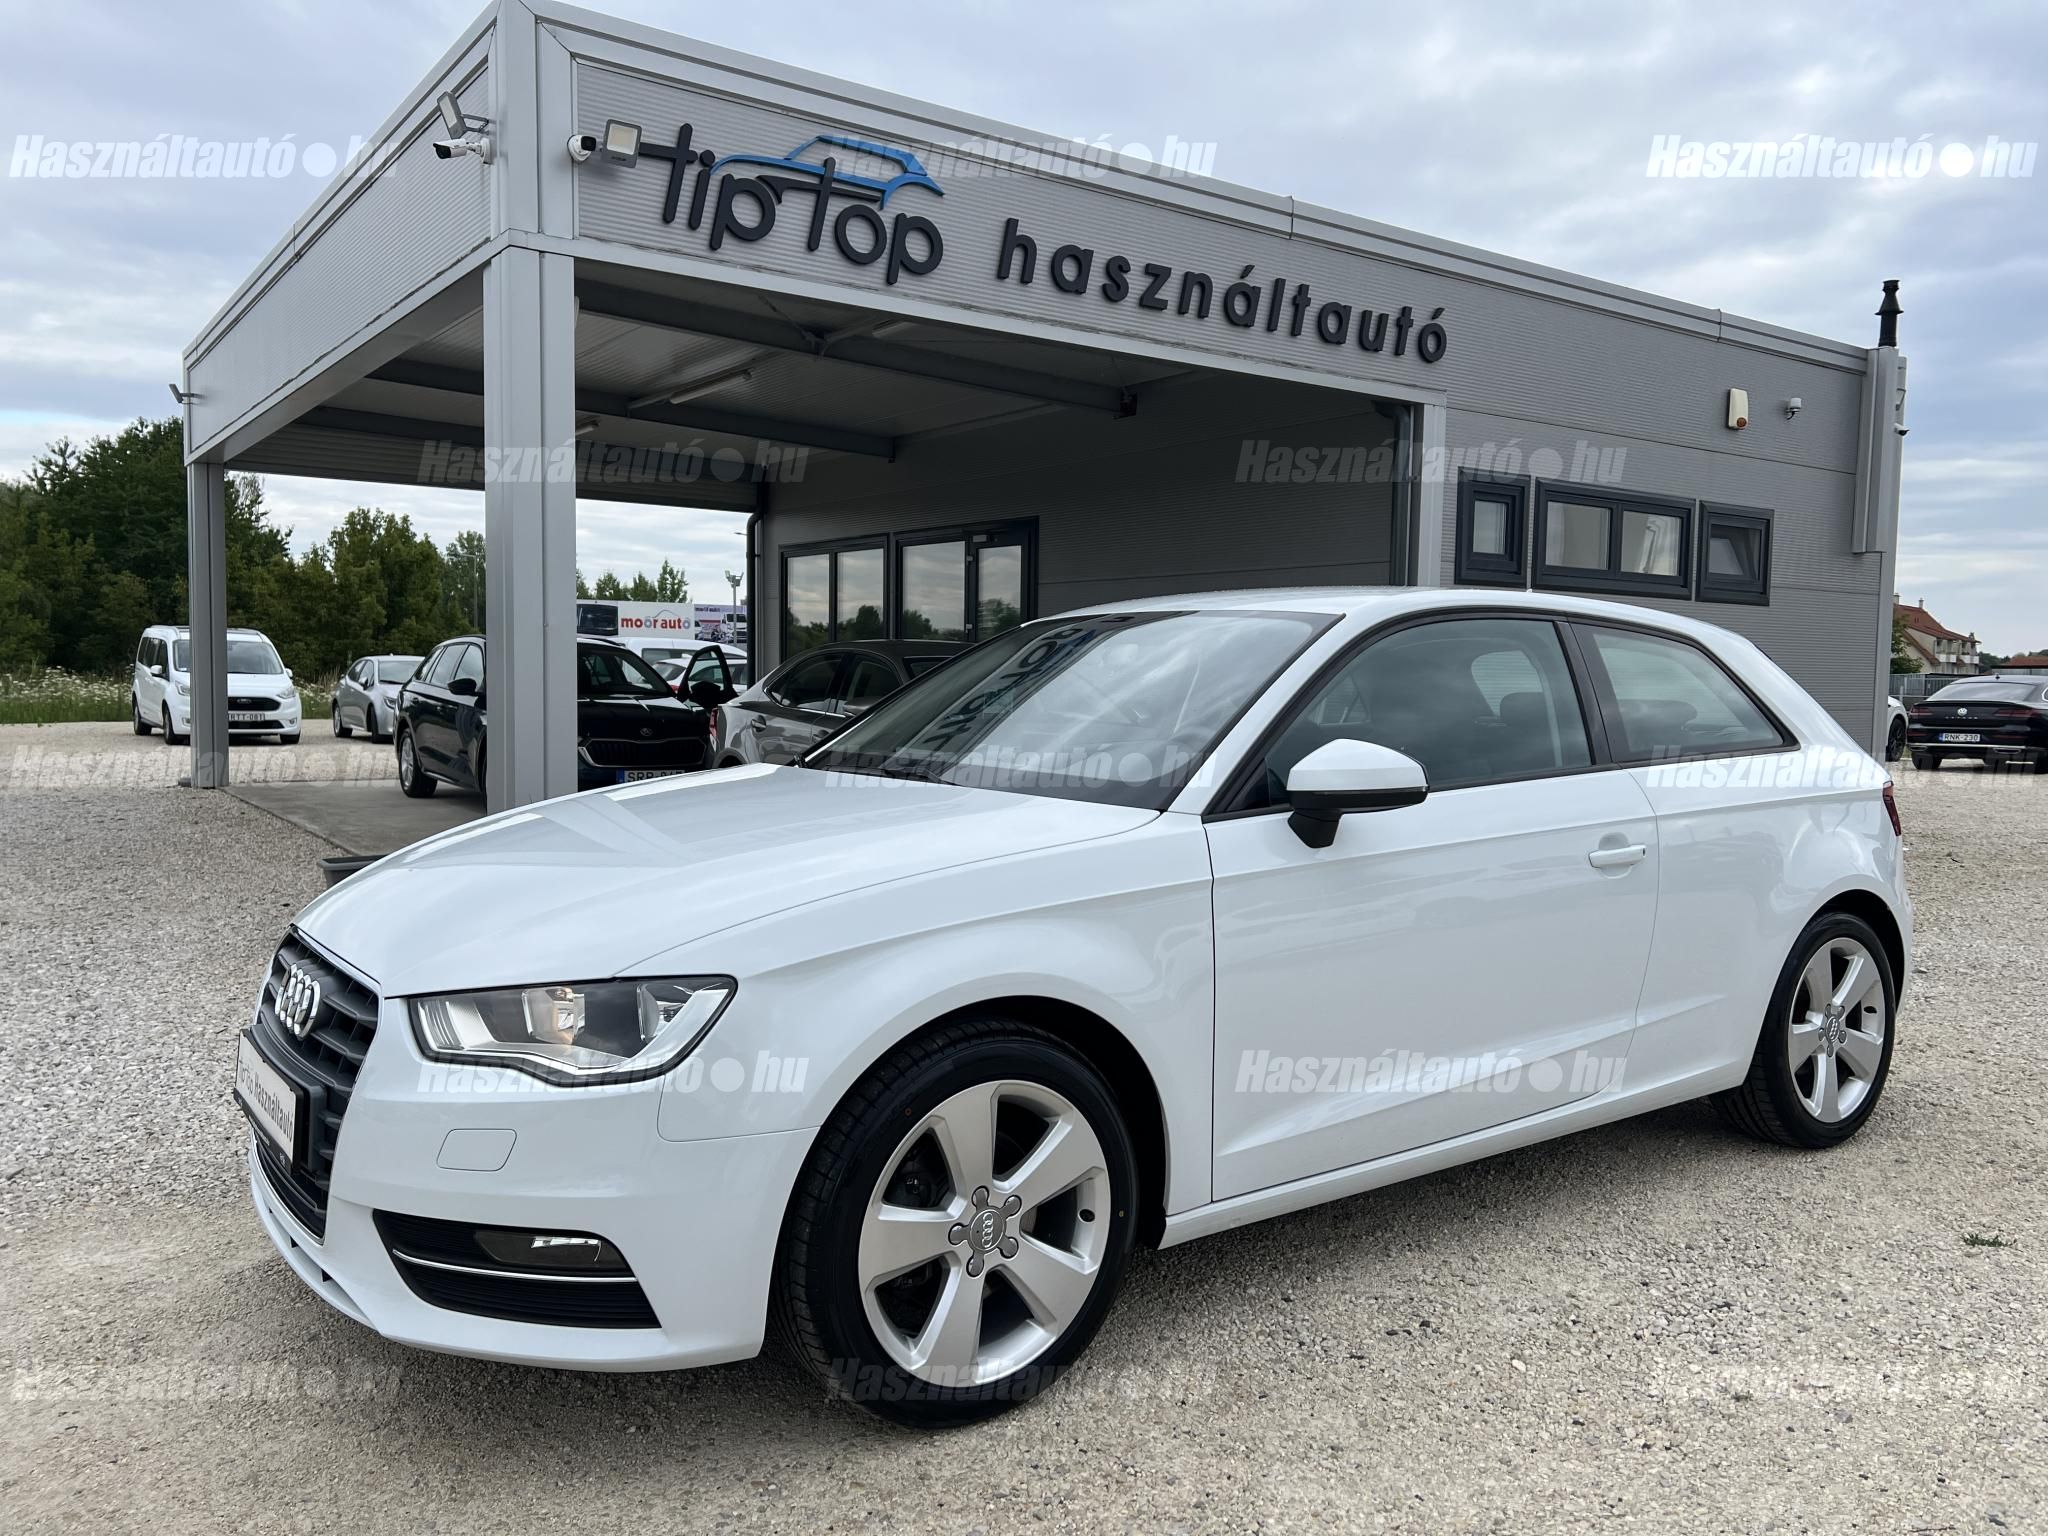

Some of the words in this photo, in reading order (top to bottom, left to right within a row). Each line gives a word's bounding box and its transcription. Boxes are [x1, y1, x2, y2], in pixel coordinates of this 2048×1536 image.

[641, 122, 781, 251] tip
[757, 157, 944, 285] top
[997, 216, 1448, 365] használtautó
[1944, 732, 1979, 742] RNK-230
